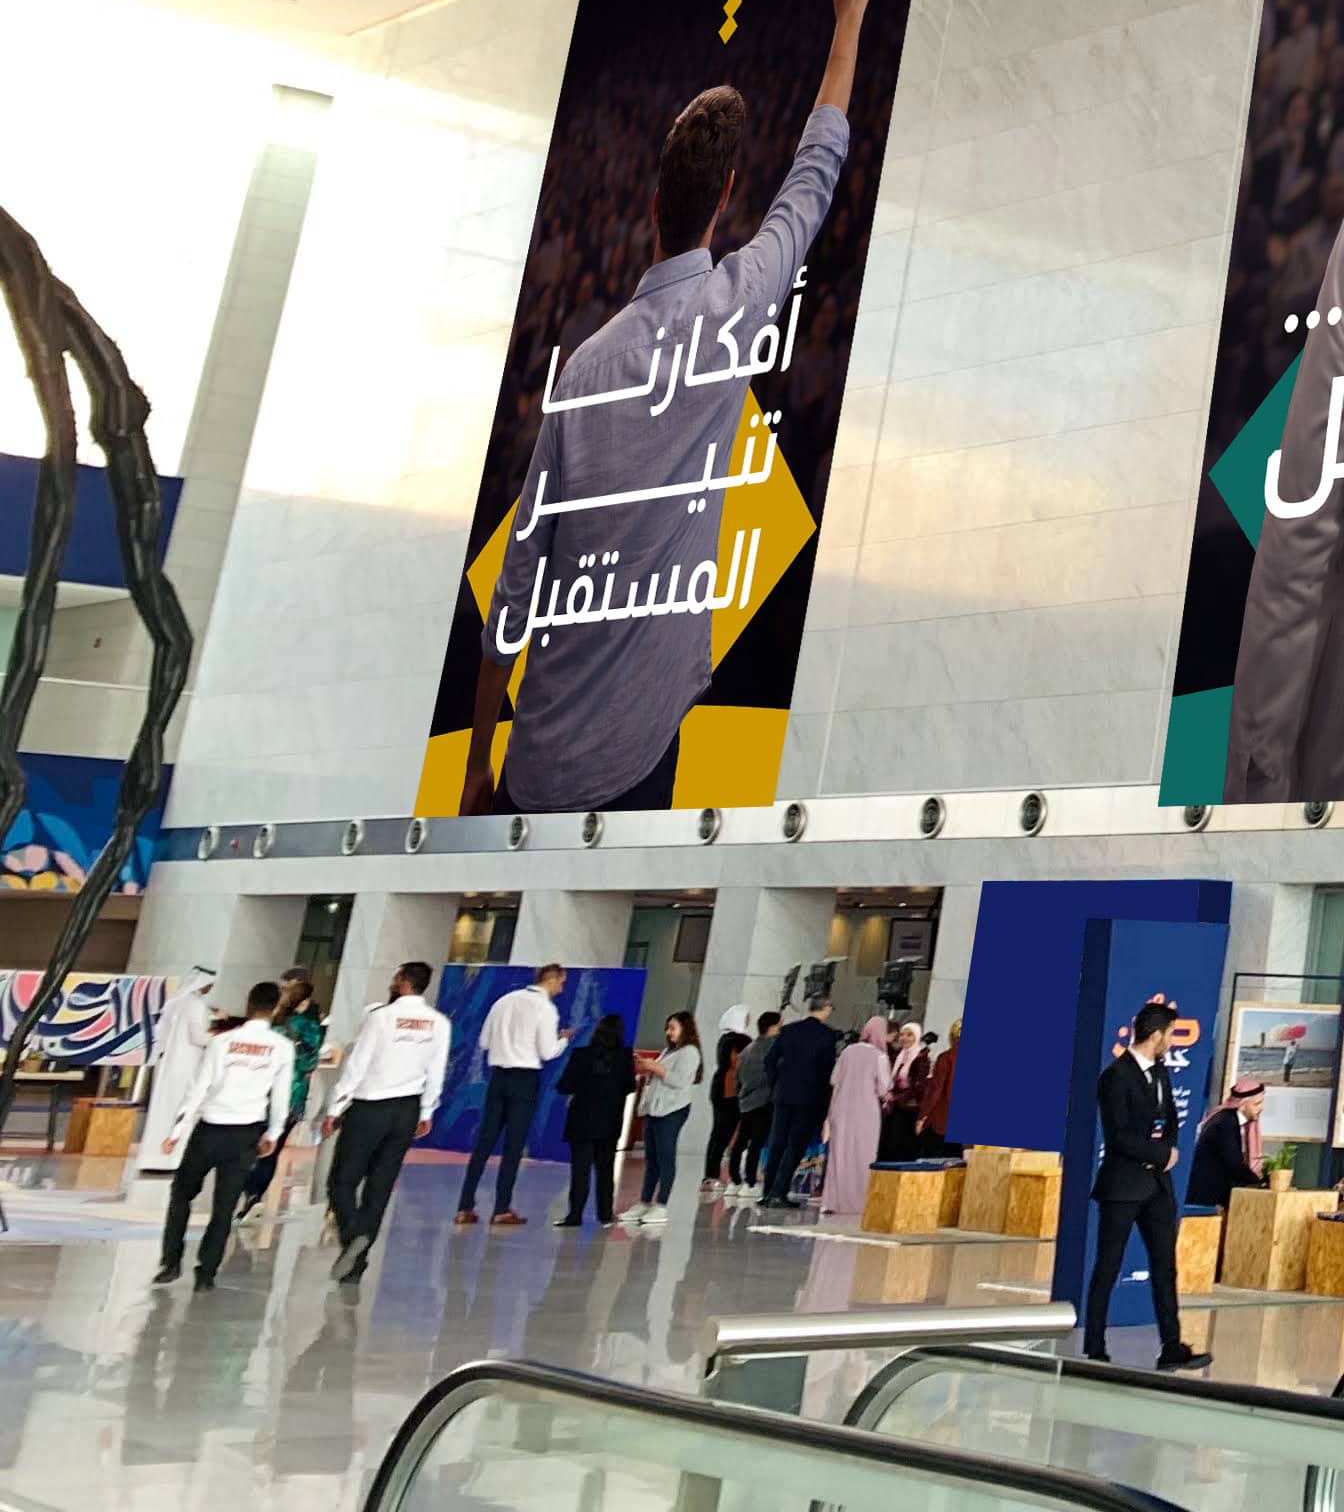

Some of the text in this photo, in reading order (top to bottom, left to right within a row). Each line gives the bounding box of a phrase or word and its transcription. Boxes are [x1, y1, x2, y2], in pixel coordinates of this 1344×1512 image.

[541, 266, 808, 417] أفكارنا
[516, 410, 782, 541] تنير
[495, 528, 761, 656] المستقبل
[227, 1041, 273, 1057] SECURITY
[396, 1017, 434, 1030] SECURITY
